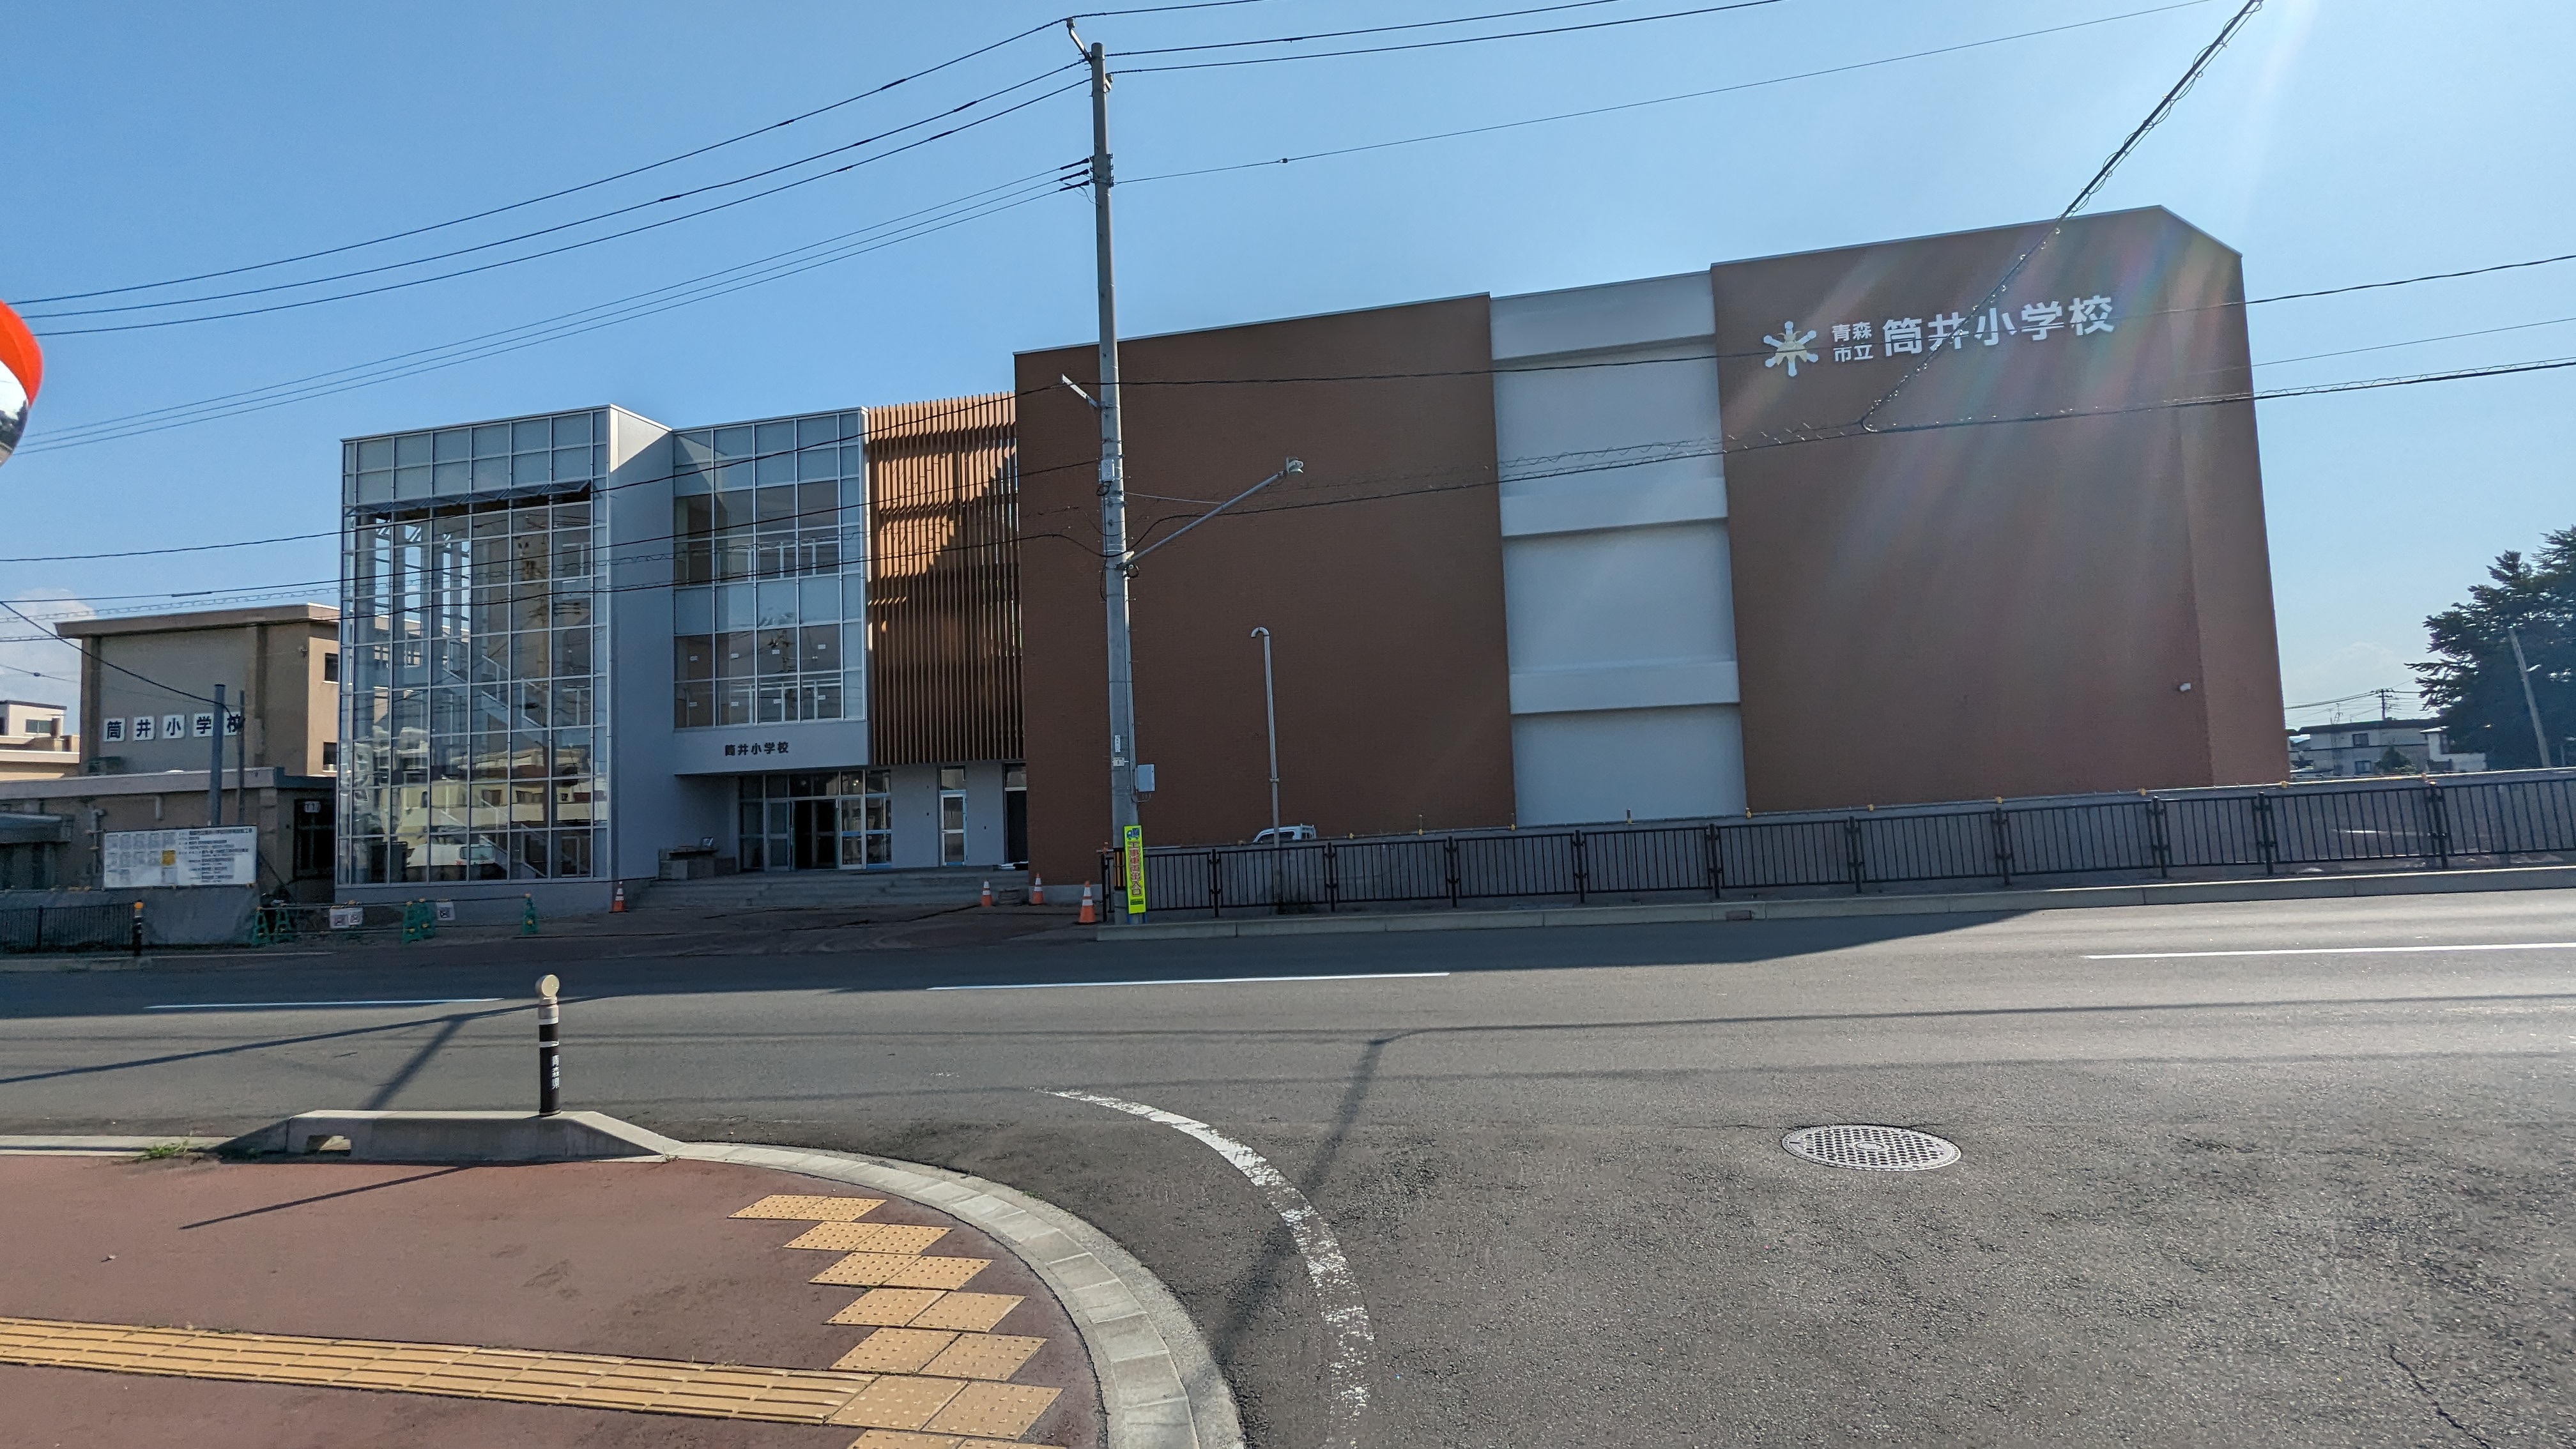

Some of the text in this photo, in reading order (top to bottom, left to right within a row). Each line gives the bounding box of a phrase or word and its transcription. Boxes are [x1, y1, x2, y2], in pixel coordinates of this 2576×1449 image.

[1832, 321, 1873, 342] 青森
[1882, 295, 2115, 356] 筒井小学校
[1833, 343, 1874, 363] 市立
[725, 741, 789, 756] 筒井小学校
[1128, 841, 1142, 896] 工事車両出入口
